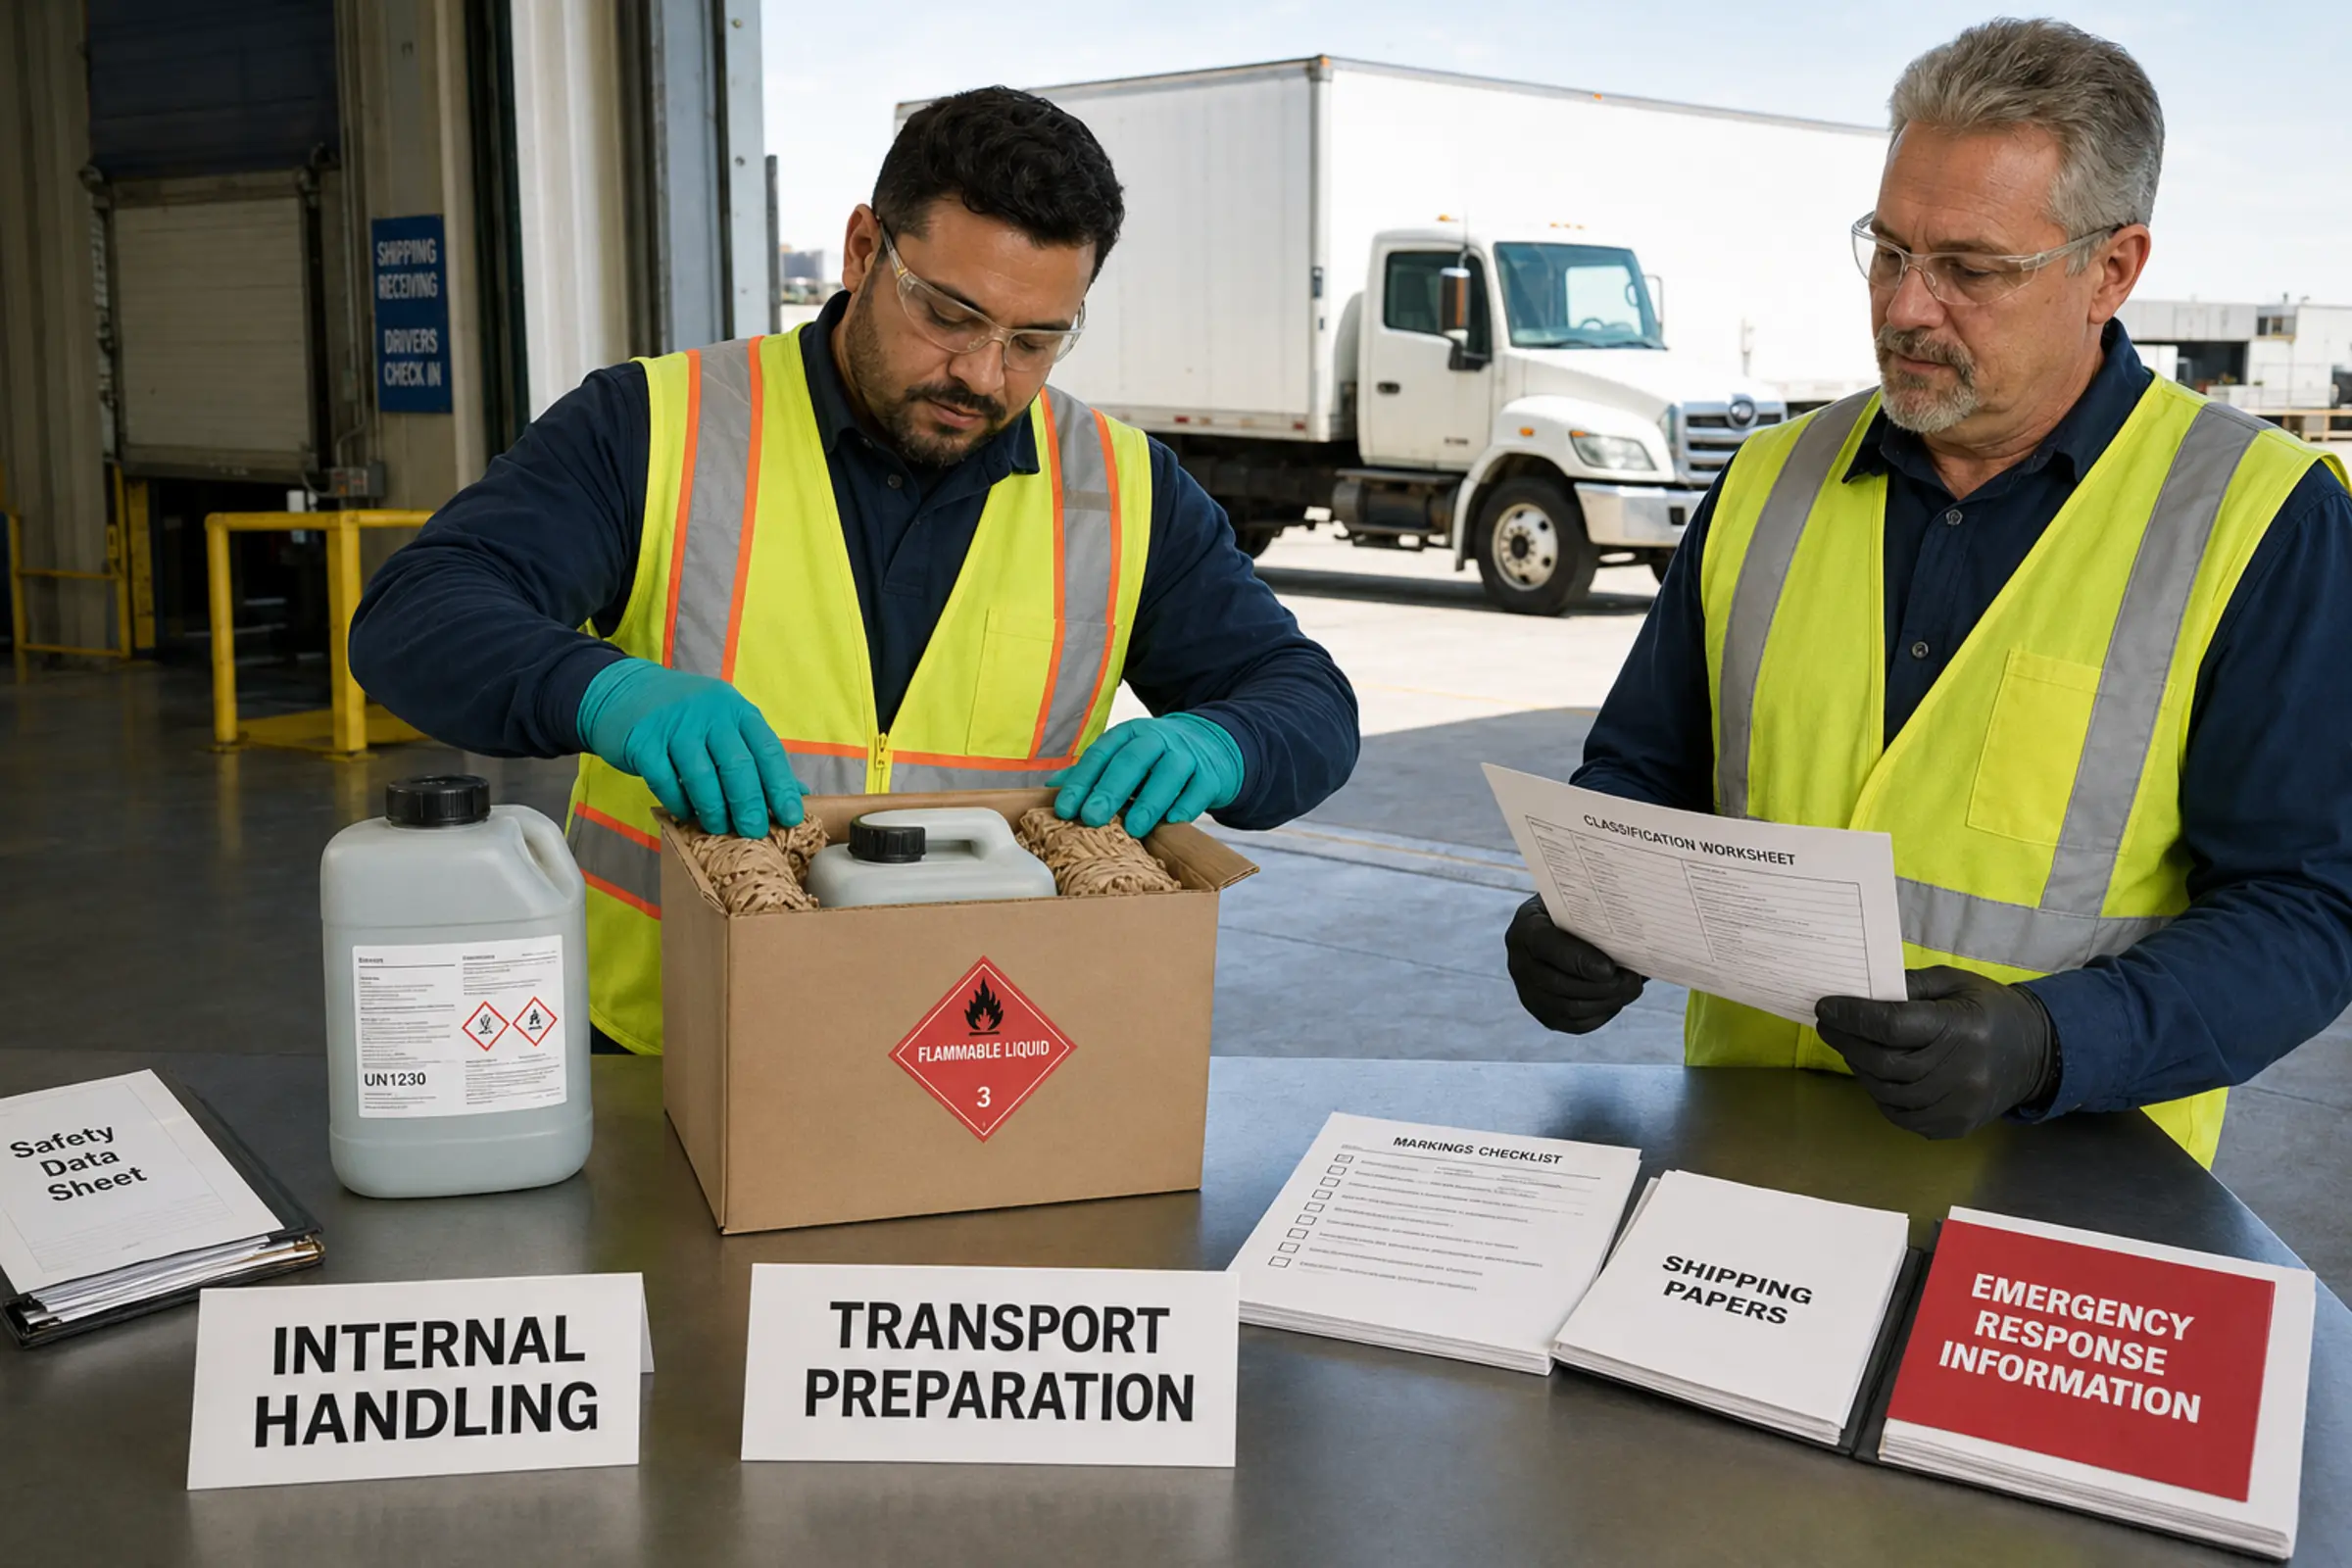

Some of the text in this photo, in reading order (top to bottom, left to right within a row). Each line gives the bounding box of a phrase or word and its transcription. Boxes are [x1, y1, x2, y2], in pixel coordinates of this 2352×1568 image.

[377, 238, 437, 267] SHIPPING
[379, 272, 437, 299] RECEIVING
[385, 329, 438, 354] DRIVERS
[384, 362, 441, 385] CHECK IN
[1584, 814, 1795, 865] CLASSIFICATION WORKSHEET
[918, 1040, 1050, 1062] FLAMMABLE LIQUID
[364, 1072, 426, 1087] UN1230
[977, 1086, 991, 1107] 3
[10, 1126, 115, 1158] Safety
[1393, 1137, 1563, 1164] MARKINGS CHECKLIST
[39, 1151, 120, 1177] Data
[47, 1166, 148, 1201] Sheet
[1662, 1255, 1813, 1304] SHIPPING
[1663, 1280, 1788, 1324] PAPERS
[1971, 1273, 2194, 1341] EMERGENCY
[829, 1300, 1170, 1353] TRANSPORT
[1974, 1309, 2168, 1376] RESPONSE
[273, 1314, 586, 1376] INTERNAL
[805, 1368, 1195, 1422] PREPARATION
[1938, 1340, 2202, 1423] INFORMATION
[254, 1381, 599, 1448] HANDLING
